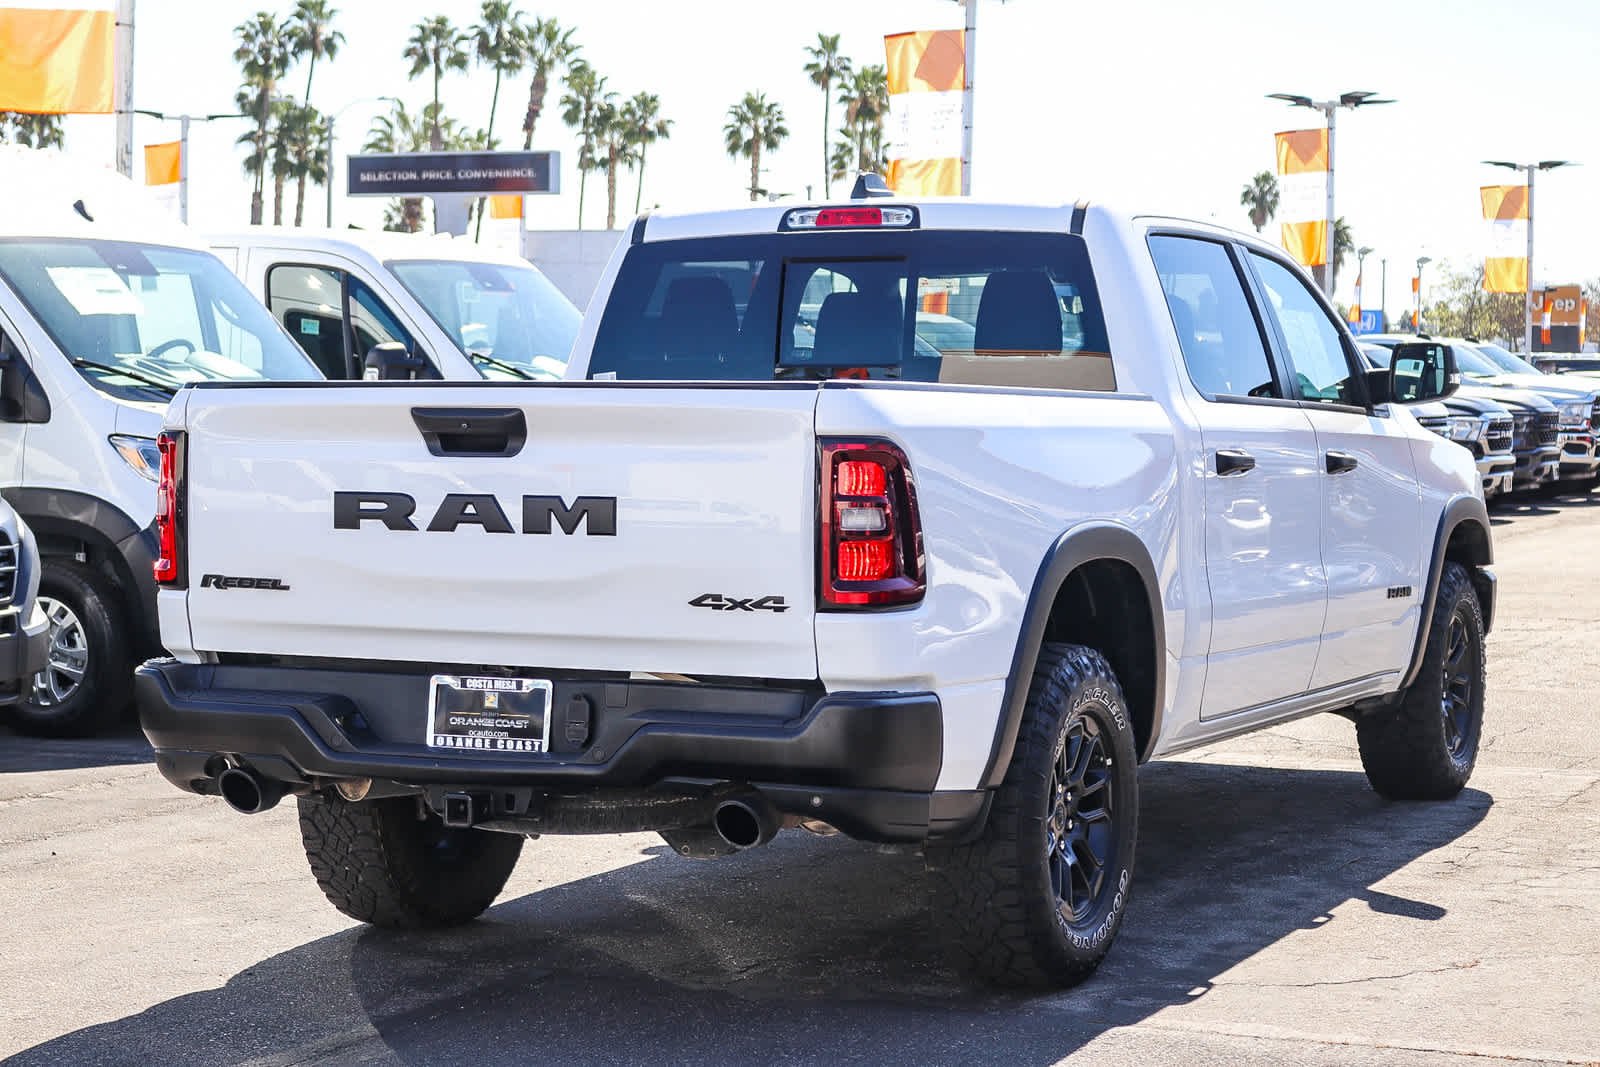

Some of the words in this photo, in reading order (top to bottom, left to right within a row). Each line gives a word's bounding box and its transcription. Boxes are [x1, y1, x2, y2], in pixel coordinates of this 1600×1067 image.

[360, 171, 419, 183] SELECTION.
[458, 167, 537, 180] CONVENIENCE.
[1532, 296, 1575, 312] Jep
[334, 491, 617, 537] RAM
[466, 679, 493, 688] COSTA
[494, 681, 517, 690] MESA
[449, 717, 494, 726] ORANGE
[495, 719, 529, 729] COAST
[468, 730, 508, 738] ocauto.com
[436, 737, 490, 749] ORANGE
[497, 740, 541, 751] COAST
